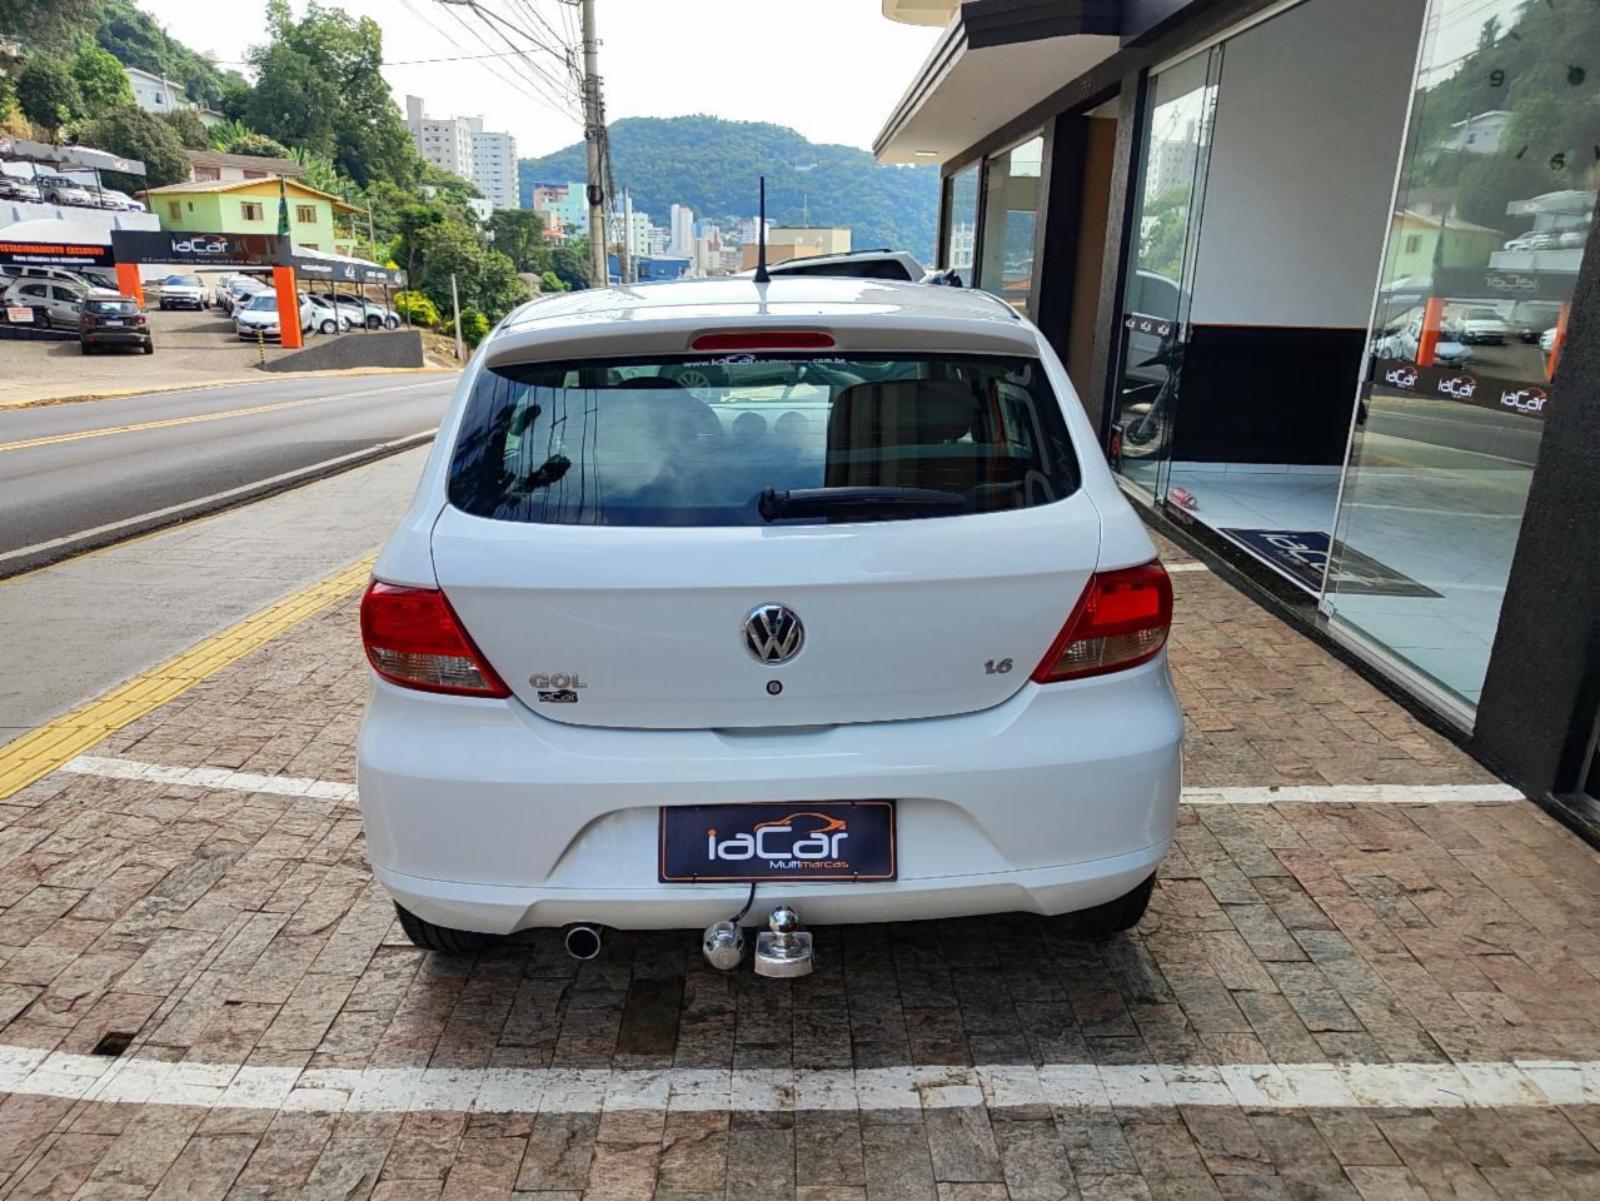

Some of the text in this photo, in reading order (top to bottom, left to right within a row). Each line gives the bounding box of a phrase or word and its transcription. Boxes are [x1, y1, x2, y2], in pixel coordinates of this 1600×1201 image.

[1489, 70, 1505, 87] 9
[1386, 370, 1418, 386] iaCar
[1438, 378, 1476, 397] iaCar
[1501, 390, 1547, 411] iaCar
[529, 672, 588, 688] GOL
[708, 826, 848, 860] iaCar
[769, 860, 849, 869] Multimarcas
